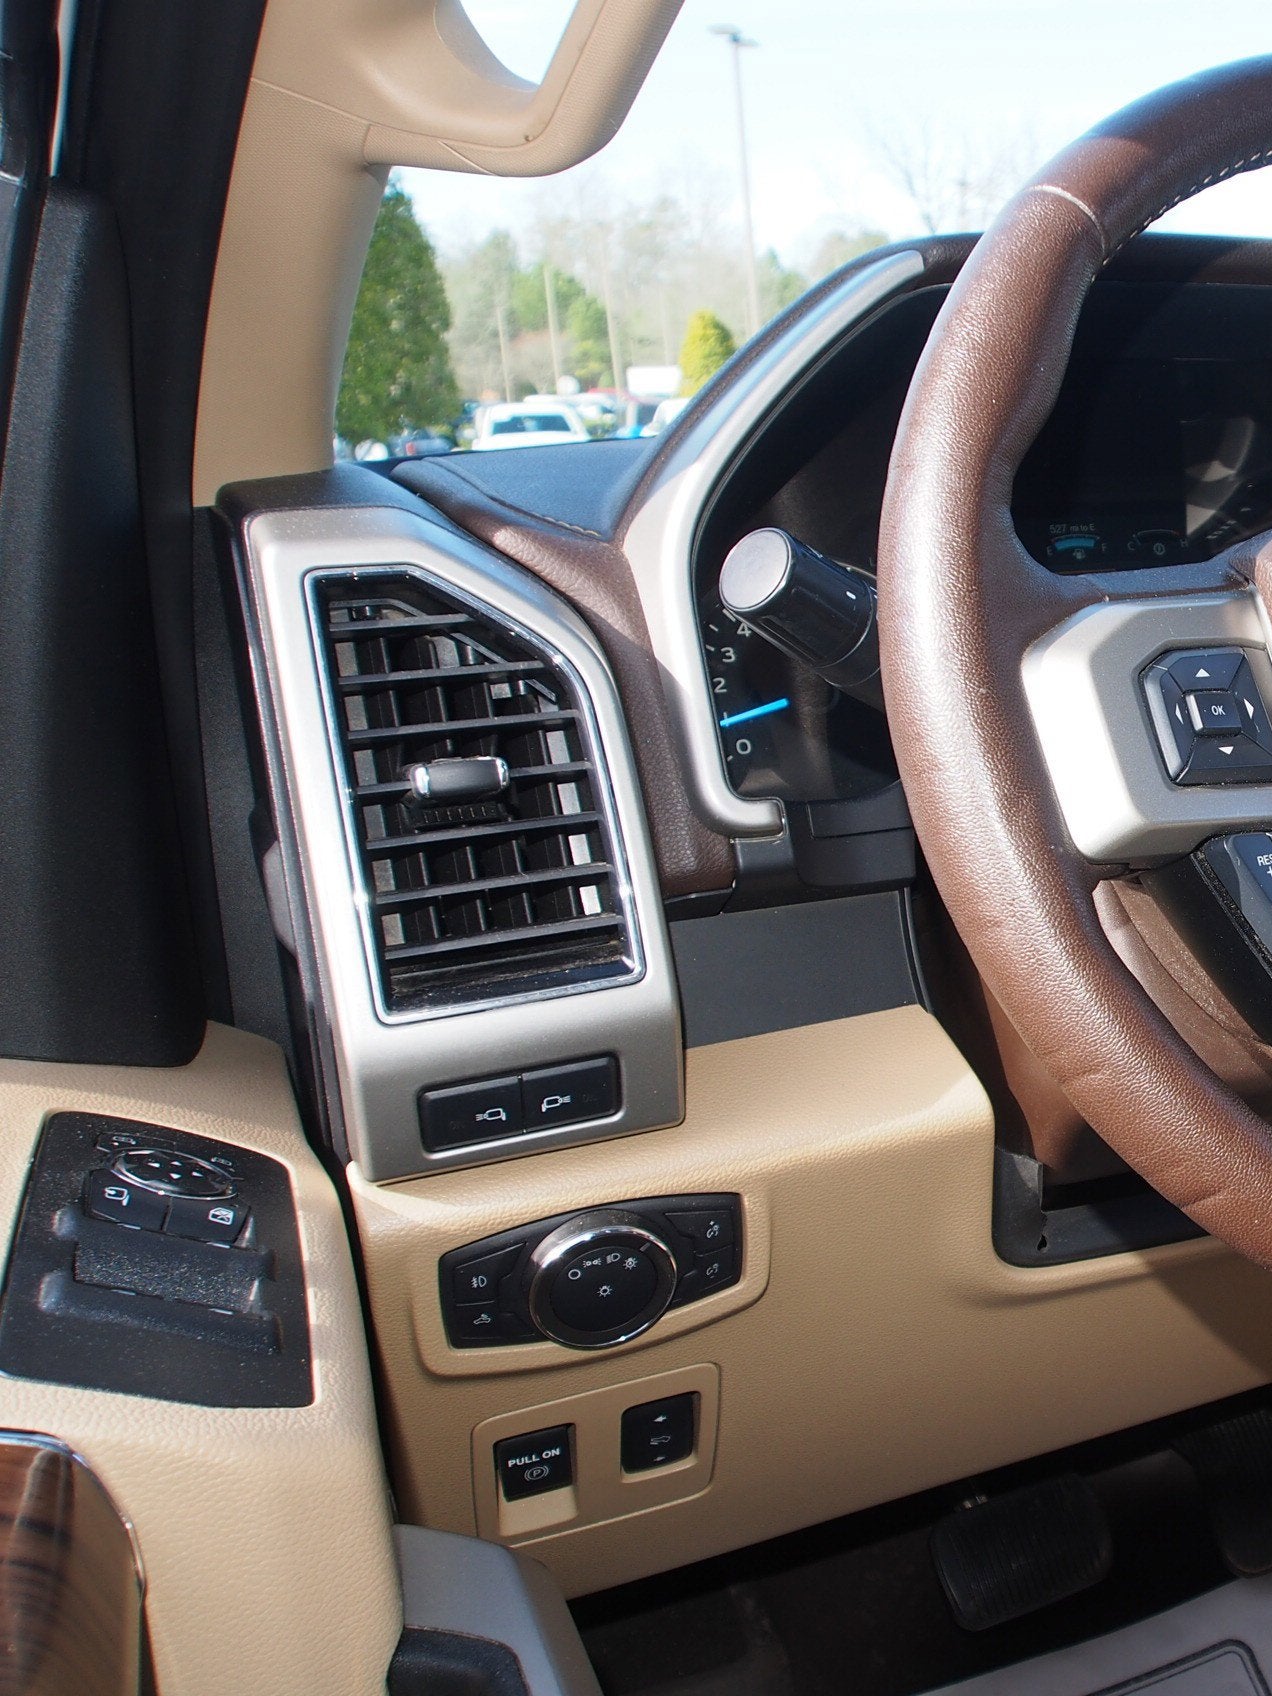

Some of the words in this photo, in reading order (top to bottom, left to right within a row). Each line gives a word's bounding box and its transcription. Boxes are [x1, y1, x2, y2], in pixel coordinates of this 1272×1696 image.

[736, 622, 751, 638] 4
[720, 647, 736, 663] 3
[712, 677, 728, 693] 2
[1211, 705, 1226, 716] OK
[507, 1454, 541, 1468] PULL
[541, 1447, 560, 1459] ON
